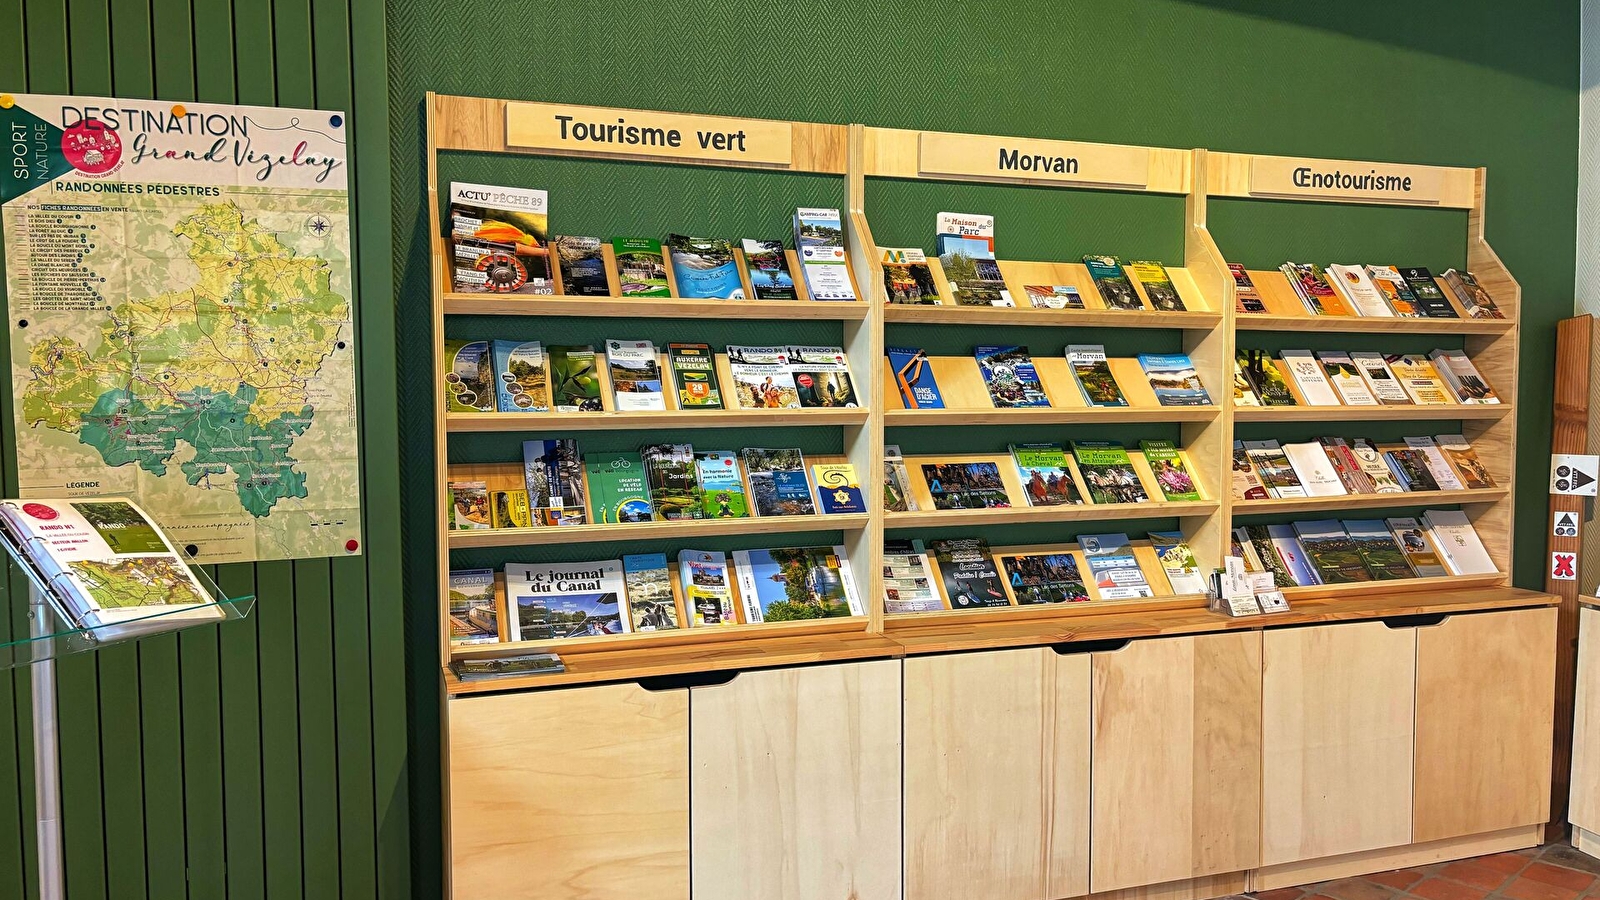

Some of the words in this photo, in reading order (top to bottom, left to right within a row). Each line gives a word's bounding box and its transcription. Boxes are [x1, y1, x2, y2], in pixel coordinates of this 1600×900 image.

[62, 106, 248, 137] DESTINATION
[555, 115, 682, 147] Tourisme
[698, 130, 746, 152] vert
[12, 121, 29, 180] SPORT
[34, 123, 49, 180] NATURE
[131, 133, 227, 164] Grand
[999, 148, 1079, 174] Morvan
[56, 181, 143, 194] RANDONNÉES
[147, 183, 220, 196] PÉDESTRES
[1293, 167, 1412, 192] Œnotourisme
[458, 190, 492, 201] ACTU'
[492, 193, 529, 206] PÊCHE
[531, 198, 543, 206] 89
[951, 218, 977, 226] Maison
[959, 226, 979, 235] Parc
[526, 571, 544, 582] Le
[548, 568, 604, 583] journal
[531, 583, 551, 592] du
[557, 580, 601, 591] Canal
